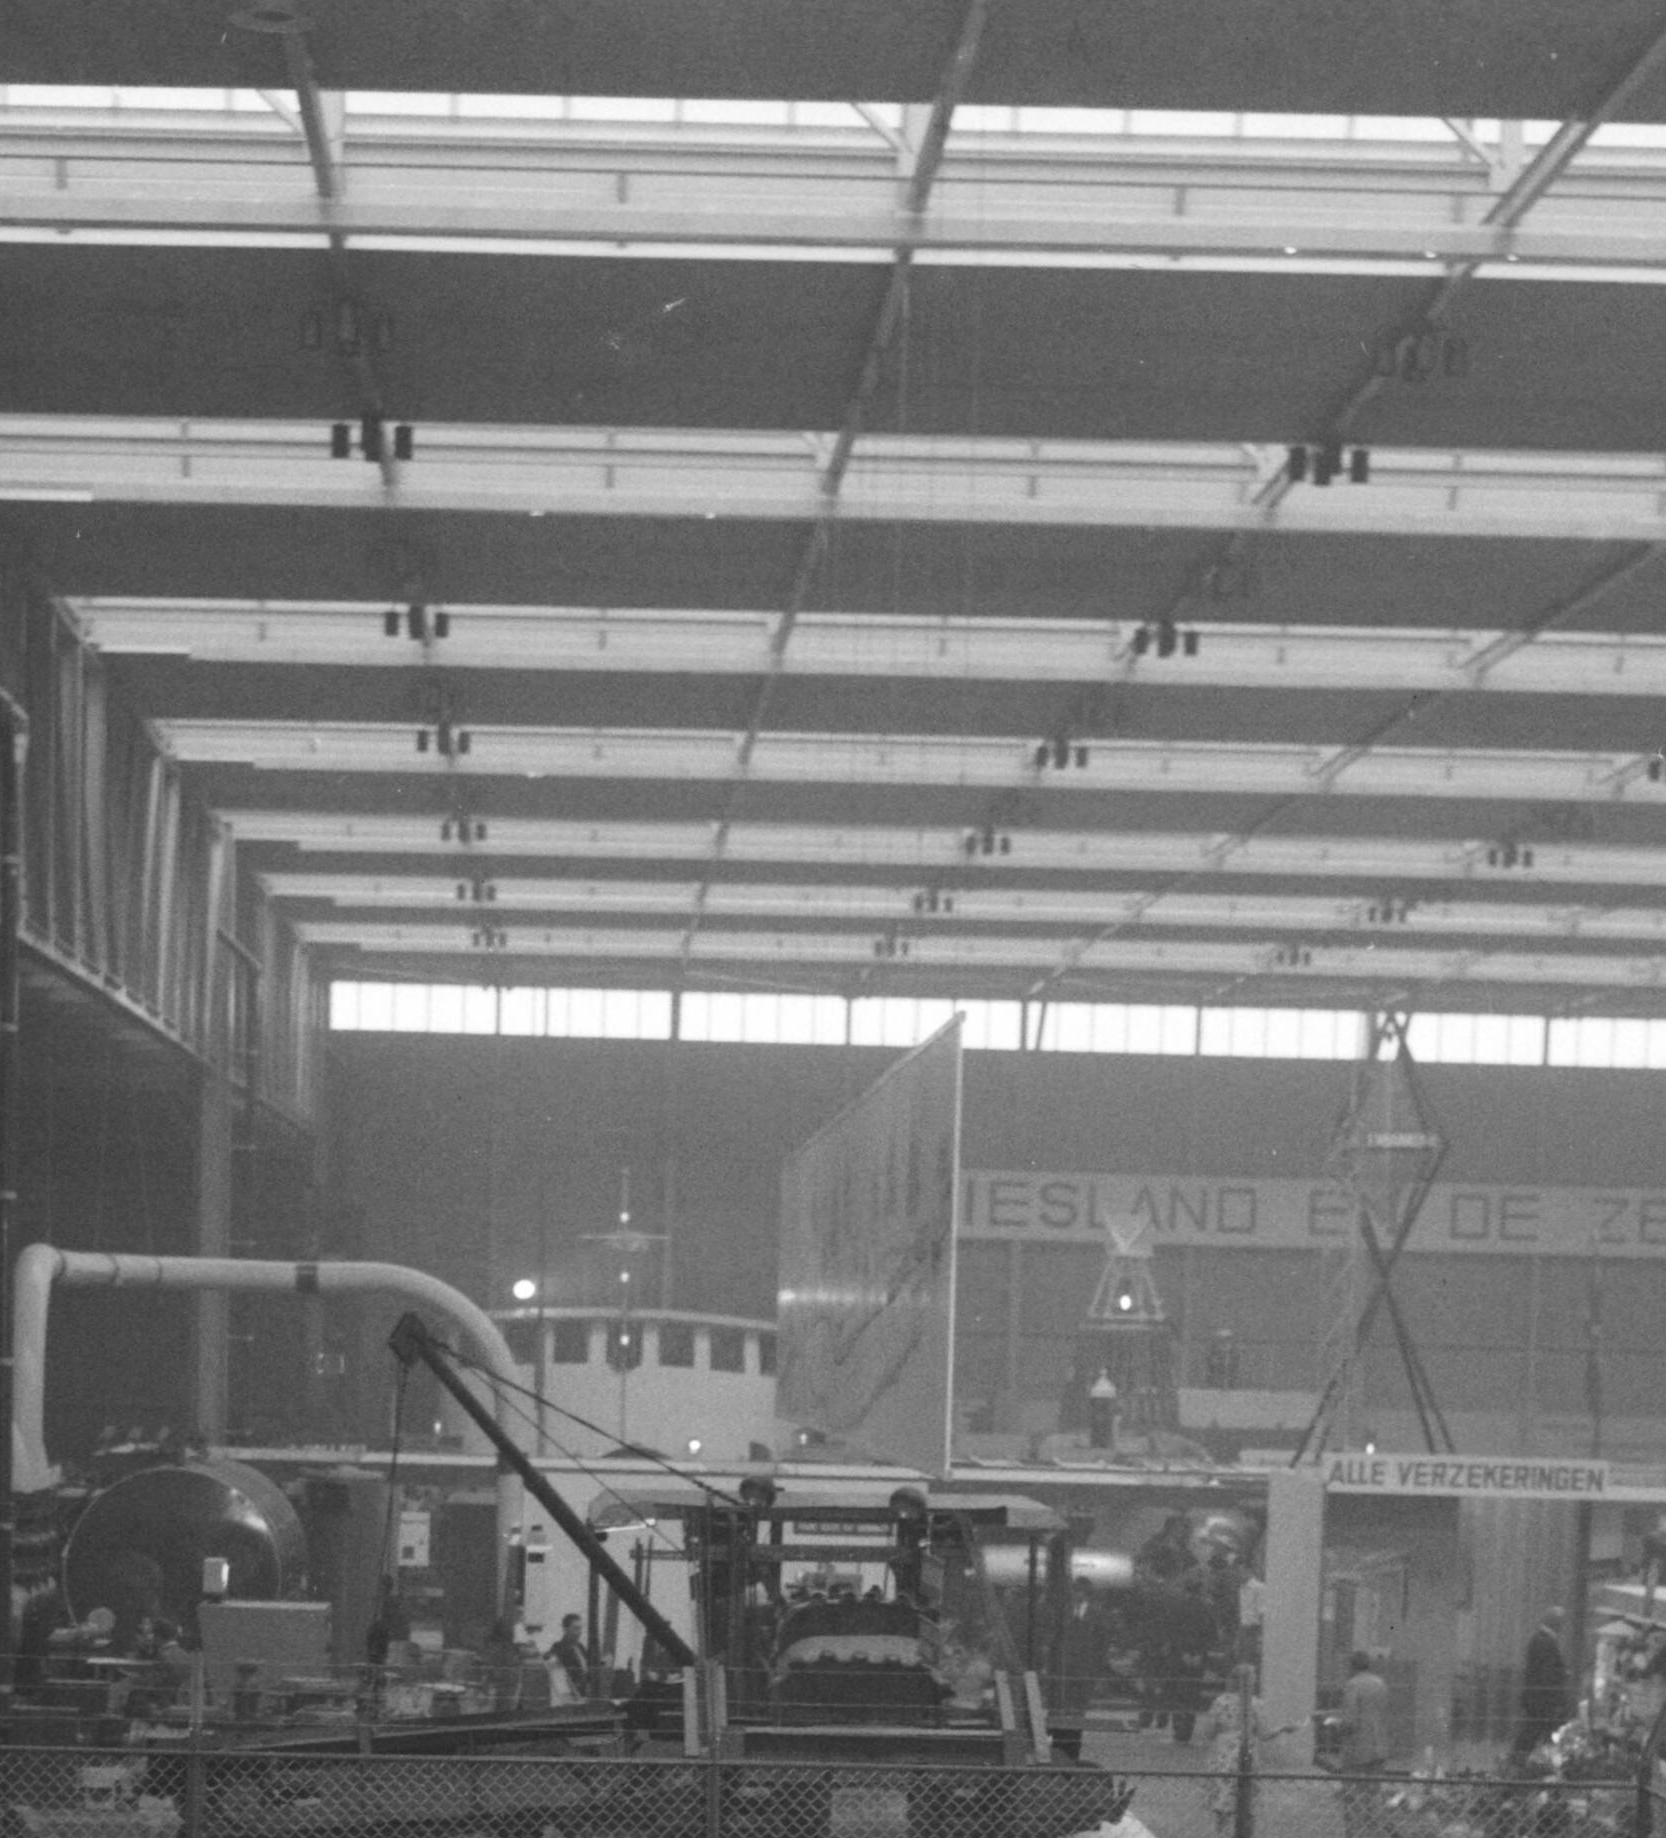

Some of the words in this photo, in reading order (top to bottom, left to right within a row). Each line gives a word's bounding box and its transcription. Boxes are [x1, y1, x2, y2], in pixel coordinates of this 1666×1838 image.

[1449, 1193, 1540, 1242] DE
[1329, 1460, 1386, 1485] ALLE
[1398, 1462, 1605, 1492] VERZEKERINGEN
